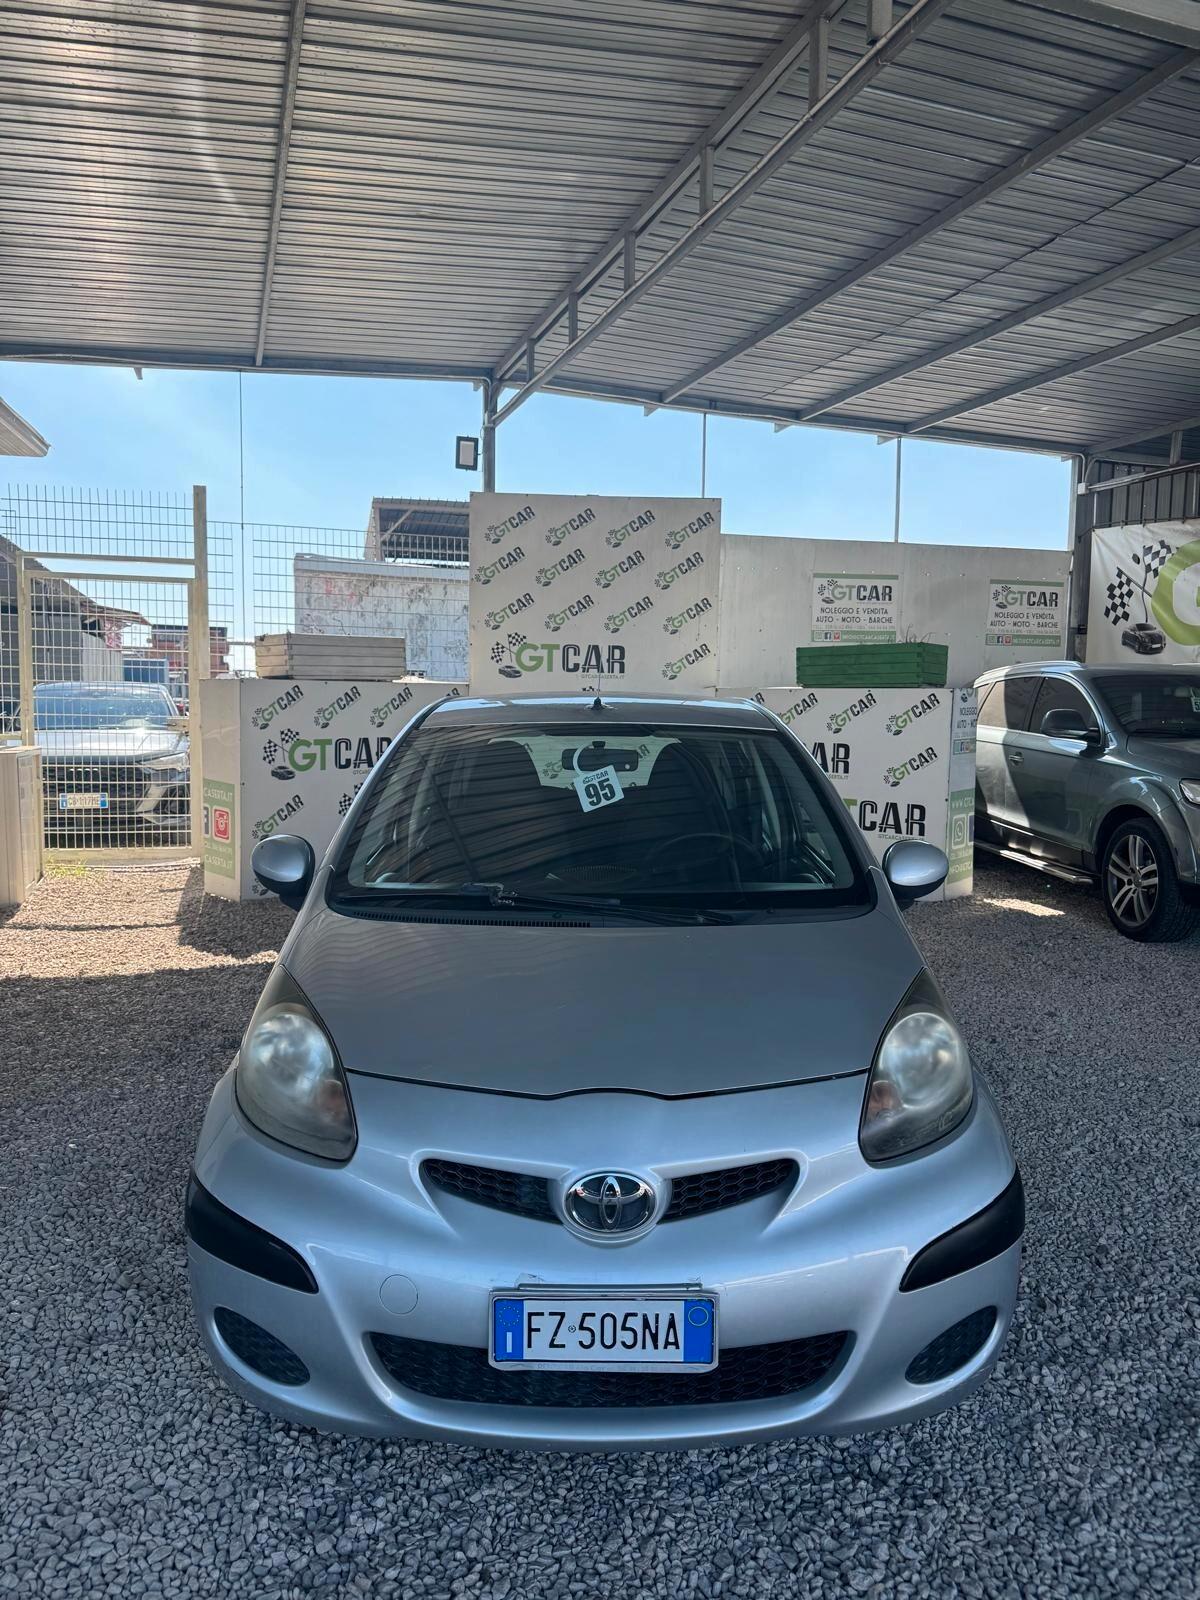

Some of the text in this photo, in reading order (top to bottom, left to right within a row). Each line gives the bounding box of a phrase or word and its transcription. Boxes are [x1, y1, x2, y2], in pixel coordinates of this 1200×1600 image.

[584, 778, 616, 806] 95
[527, 1311, 566, 1349] FZ
[578, 1311, 681, 1350] 505NA
